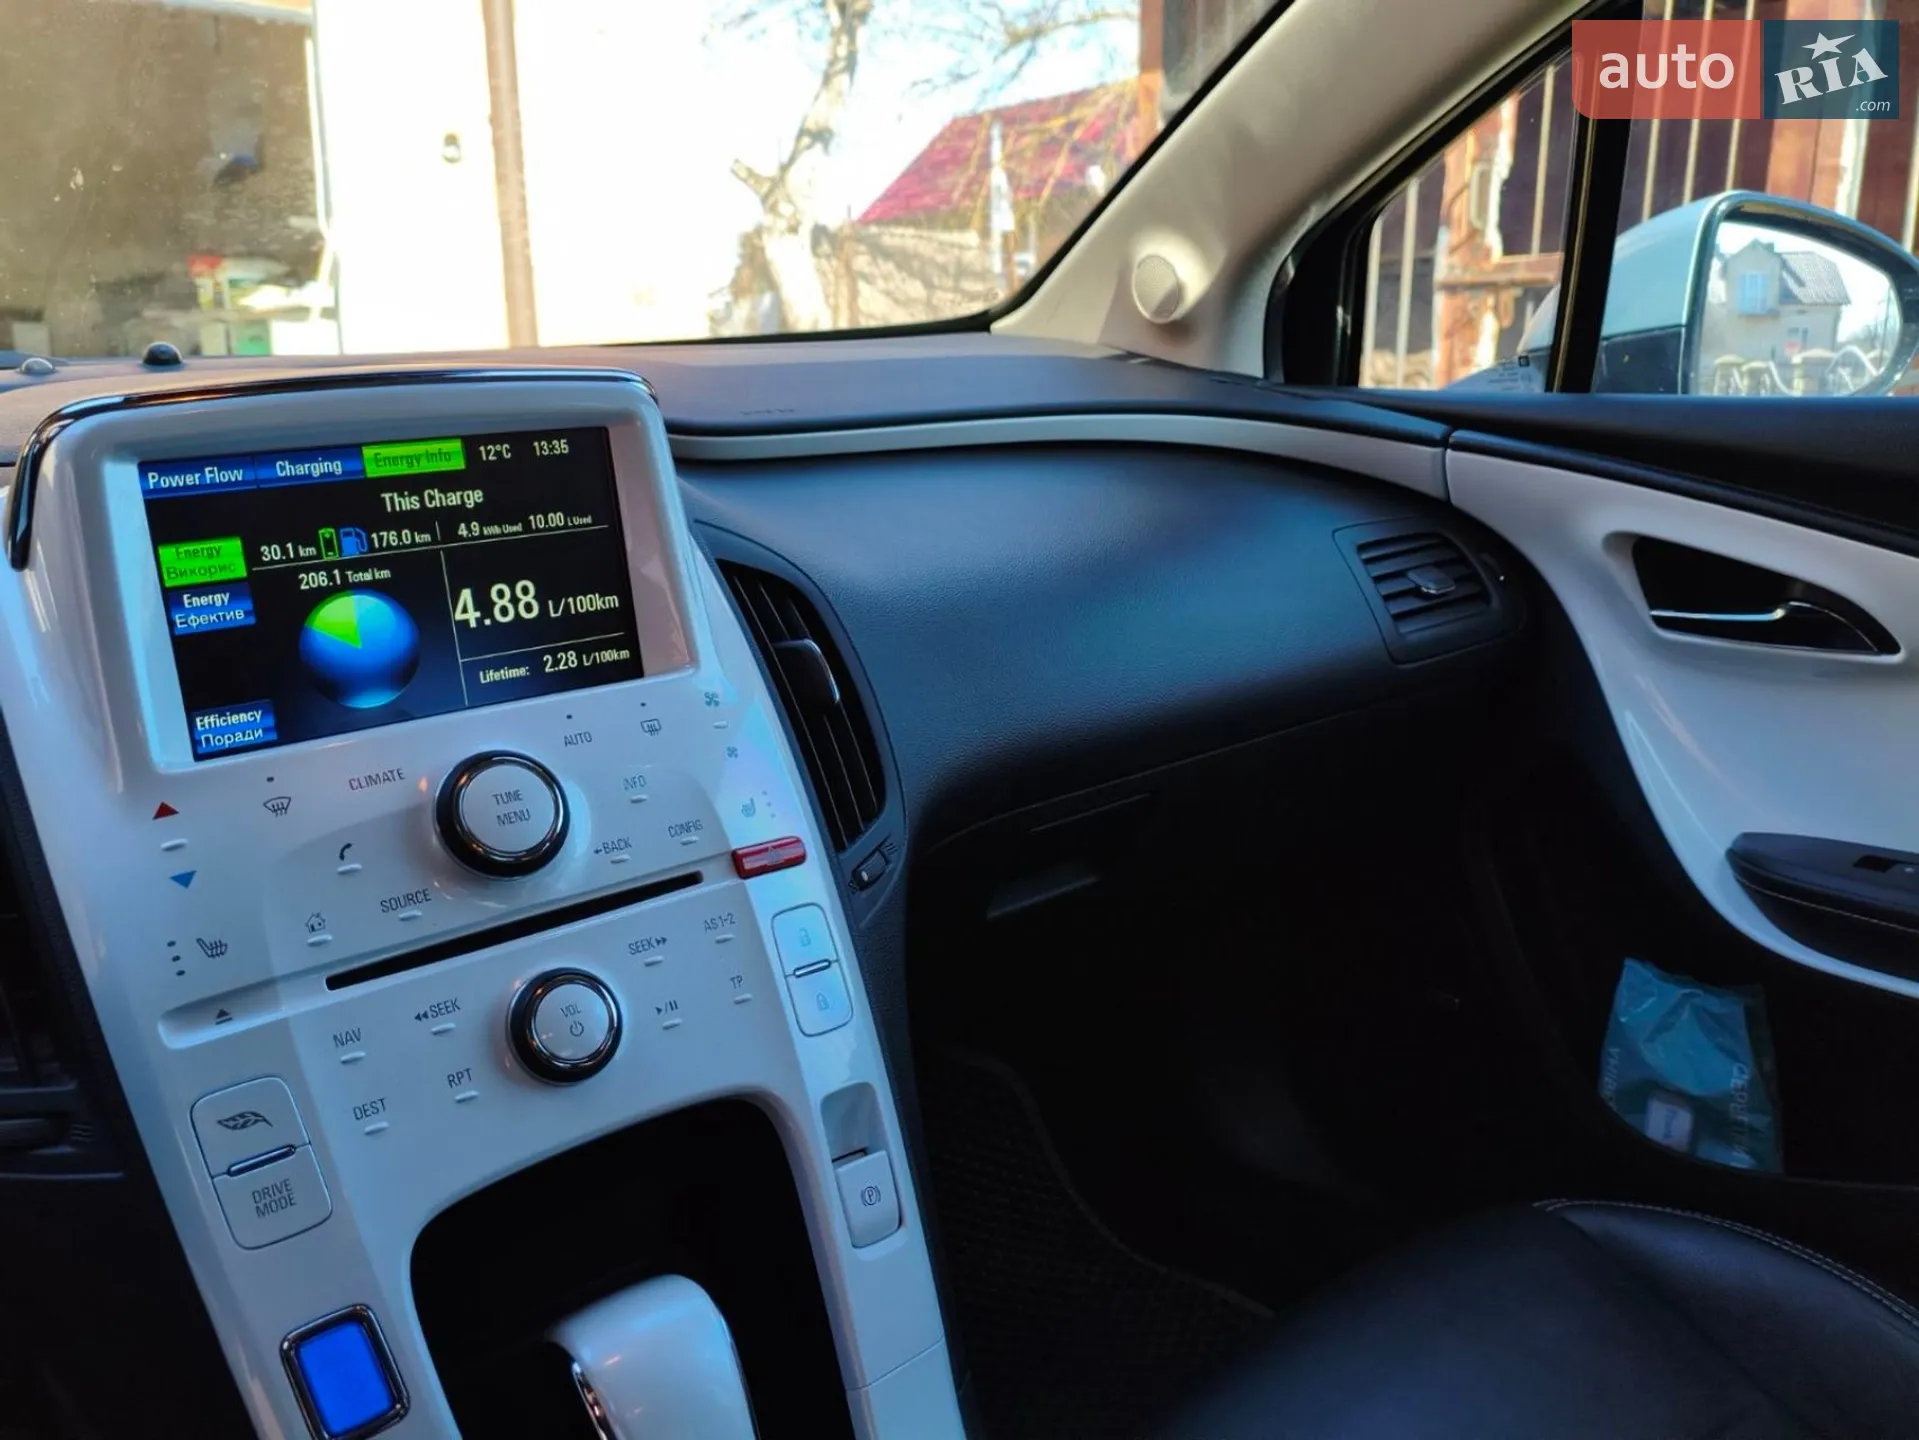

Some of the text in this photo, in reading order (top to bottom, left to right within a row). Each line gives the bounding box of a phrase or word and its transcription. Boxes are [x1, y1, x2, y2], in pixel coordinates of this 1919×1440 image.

[374, 448, 452, 469] Energy Info
[533, 439, 569, 457] 13:35
[147, 466, 244, 489] Power Flow
[275, 457, 343, 478] Charging
[381, 488, 484, 513] This Charge
[457, 521, 480, 538] 4.9
[502, 522, 523, 534] Used
[528, 511, 564, 530] 10.00
[573, 514, 592, 525] Used
[370, 530, 432, 549] 176.0 km
[174, 544, 223, 561] Energy
[260, 542, 317, 562] 30.1 km
[166, 561, 236, 581] Викорис
[298, 566, 392, 590] 206.1 Total km
[182, 592, 230, 609] Energy
[454, 579, 620, 629] 4.88 L/100km
[175, 608, 246, 630] Ефектив
[479, 647, 631, 684] Lifetime: 2.28 L/100km
[195, 709, 263, 731] Efficiency
[200, 727, 264, 749] Поради
[563, 731, 593, 747] AUTO
[348, 767, 406, 792] CLIMATE
[622, 774, 648, 791] INFO
[491, 788, 525, 806] TUNE
[496, 808, 532, 827] MENU
[667, 818, 704, 838] CONFIG
[602, 837, 633, 855] BACK
[379, 887, 432, 914] SOURCE
[628, 937, 656, 956] SEEK
[730, 975, 744, 989] TP
[429, 998, 462, 1019] SEEK
[560, 1003, 582, 1018] VOL
[332, 1027, 363, 1048] NAV
[446, 1067, 473, 1088] RPT
[352, 1097, 387, 1122] DEST
[251, 1177, 293, 1205] DRIVE
[254, 1193, 298, 1219] MODE
